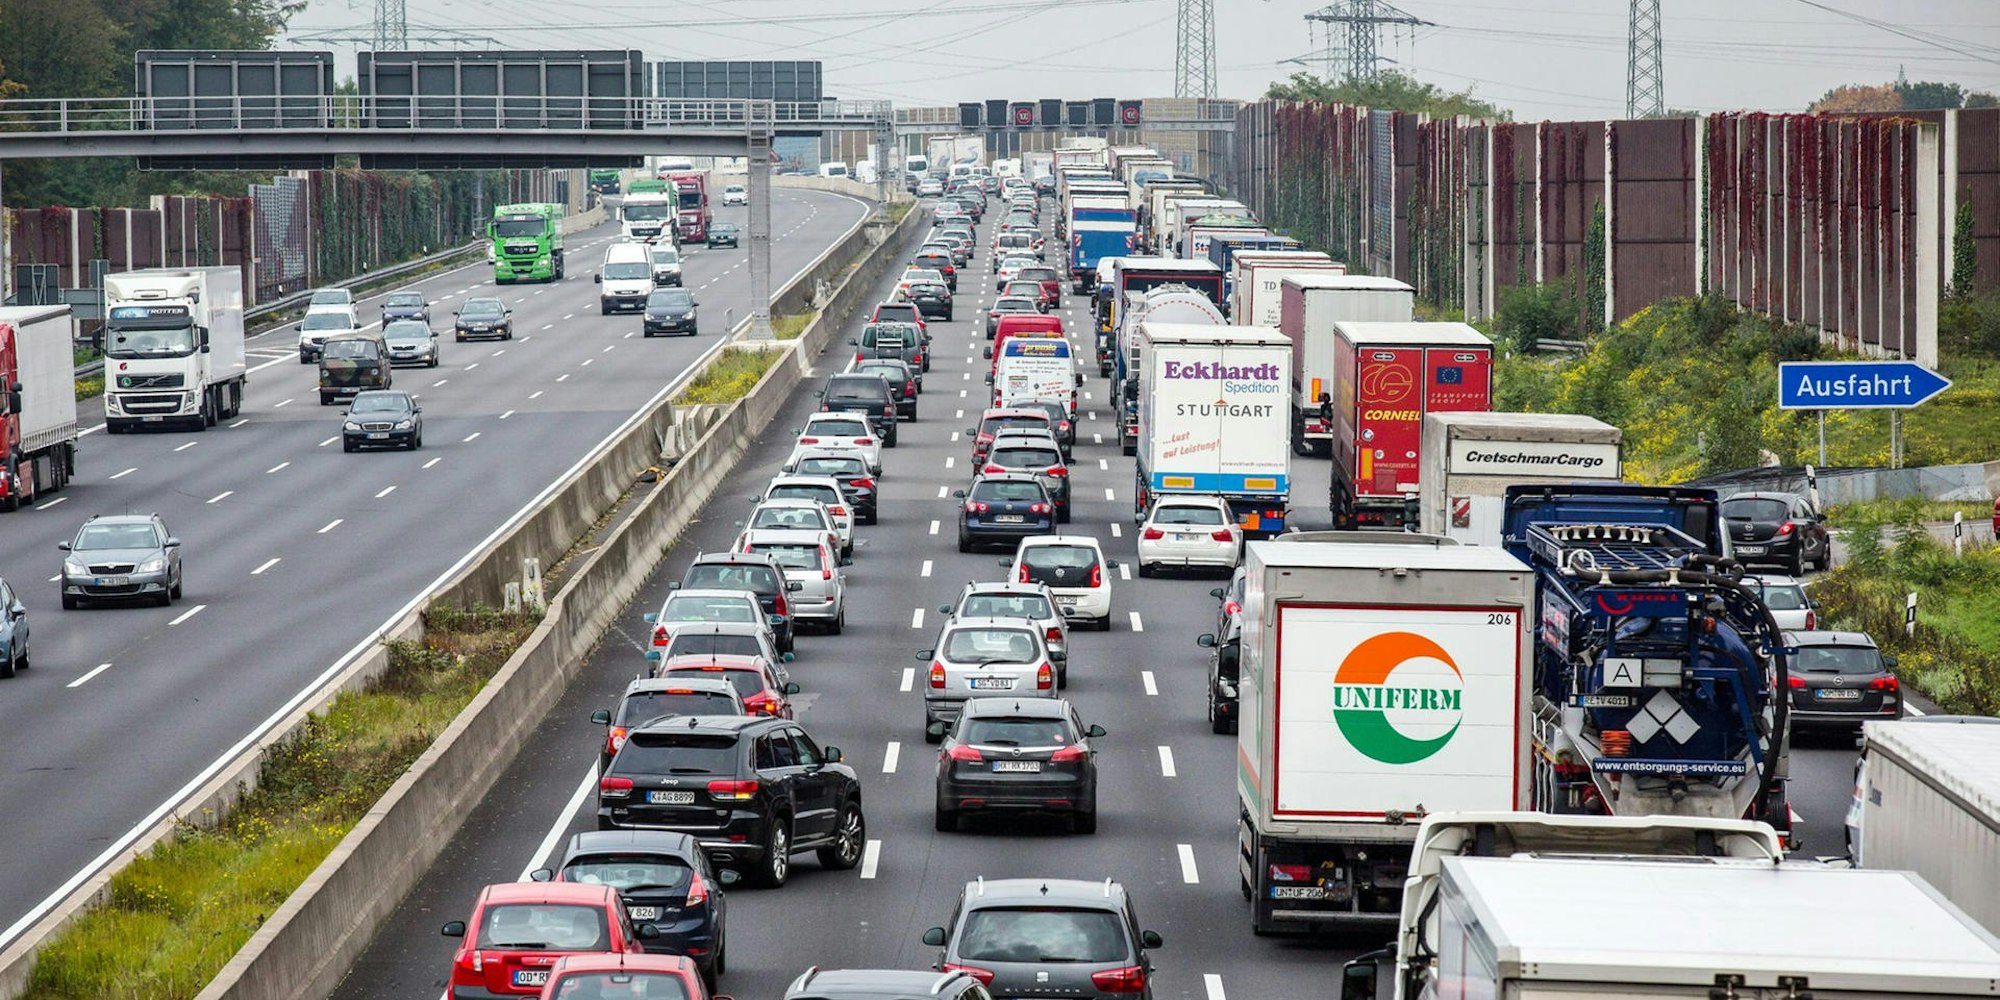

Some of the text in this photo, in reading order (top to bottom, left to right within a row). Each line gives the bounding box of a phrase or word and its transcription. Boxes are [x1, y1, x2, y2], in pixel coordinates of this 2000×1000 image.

[1164, 361, 1280, 381] Eckhardt
[1224, 381, 1280, 395] Spedition
[1796, 373, 1912, 397] Ausfahrt
[1176, 403, 1273, 417] STUTTGART
[1364, 409, 1421, 421] CORNEEL
[1162, 438, 1221, 459] auf Leistung!
[1466, 450, 1604, 468] CretschmarCargo
[1487, 613, 1512, 625] 206
[1612, 662, 1633, 683] A
[1333, 686, 1462, 711] UNIFERM
[1595, 762, 1746, 774] www.entsorgungs-service.eu
[660, 778, 679, 786] Jeep
[635, 907, 654, 917] 826
